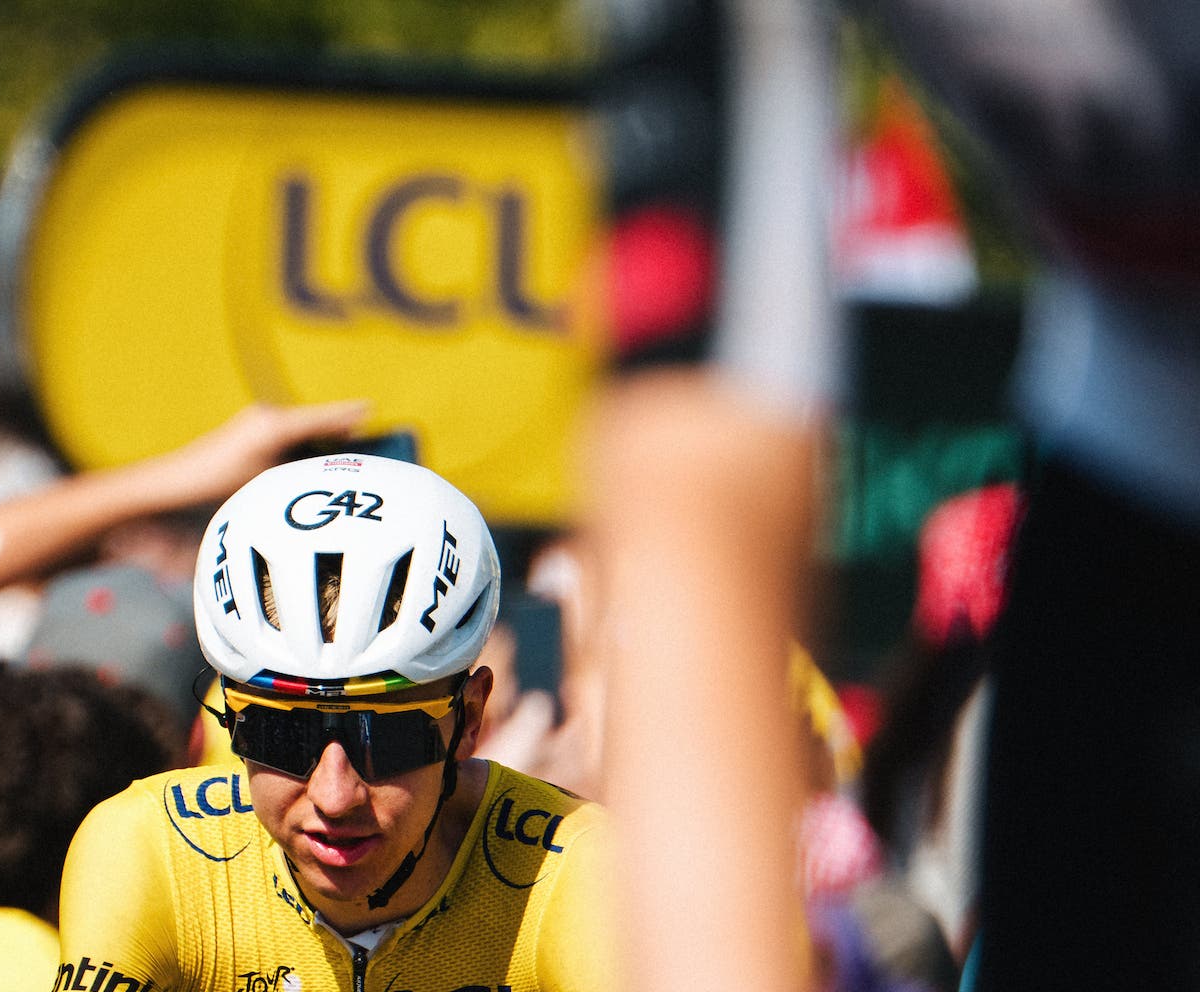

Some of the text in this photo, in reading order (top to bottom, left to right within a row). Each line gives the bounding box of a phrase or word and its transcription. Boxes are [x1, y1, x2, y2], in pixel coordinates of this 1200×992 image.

[280, 170, 571, 333] LCL
[284, 489, 384, 531] G42
[215, 520, 241, 620] MET
[419, 520, 461, 633] MET
[171, 773, 254, 819] LCL
[495, 798, 565, 853] LCL
